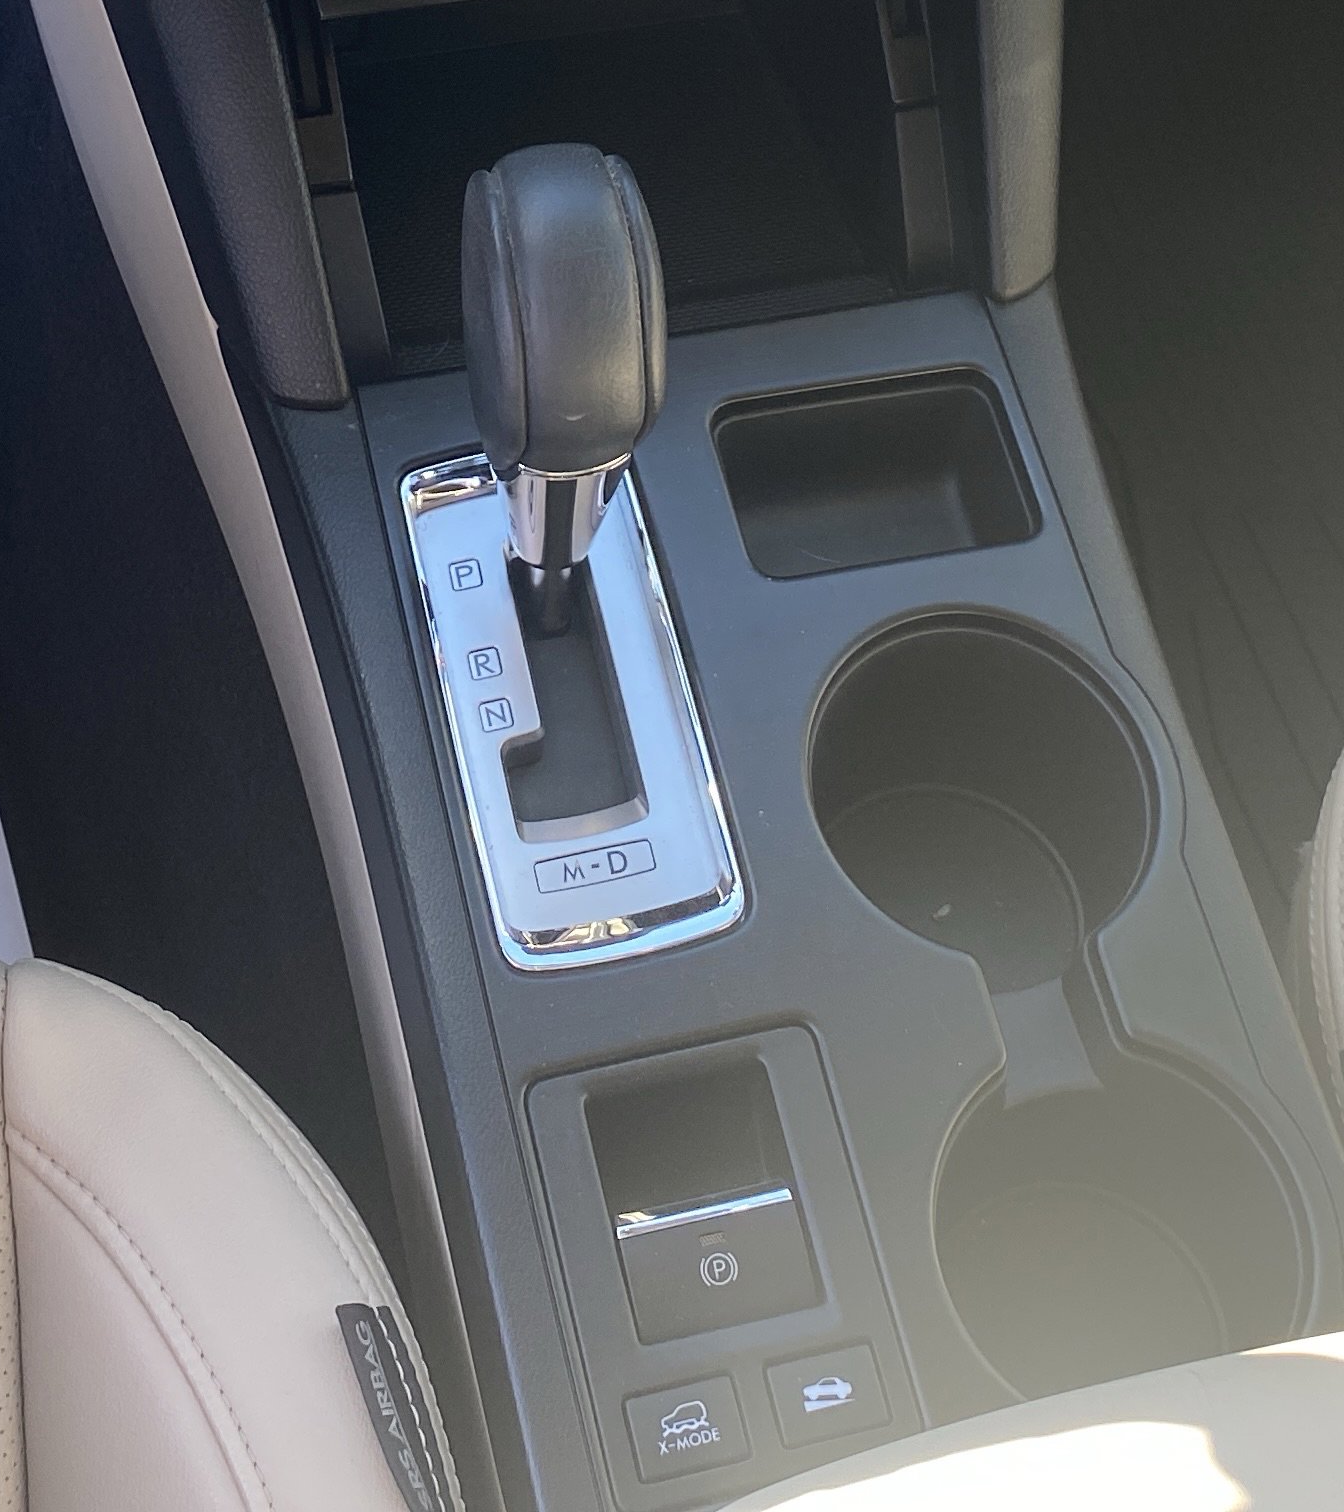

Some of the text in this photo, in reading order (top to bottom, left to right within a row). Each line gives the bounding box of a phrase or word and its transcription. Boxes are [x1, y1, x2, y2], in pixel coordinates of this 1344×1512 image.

[454, 565, 473, 587] P
[474, 654, 495, 676] R
[485, 703, 506, 726] N
[356, 1320, 406, 1443] AIRBAG
[658, 1428, 721, 1455] X-MODE
